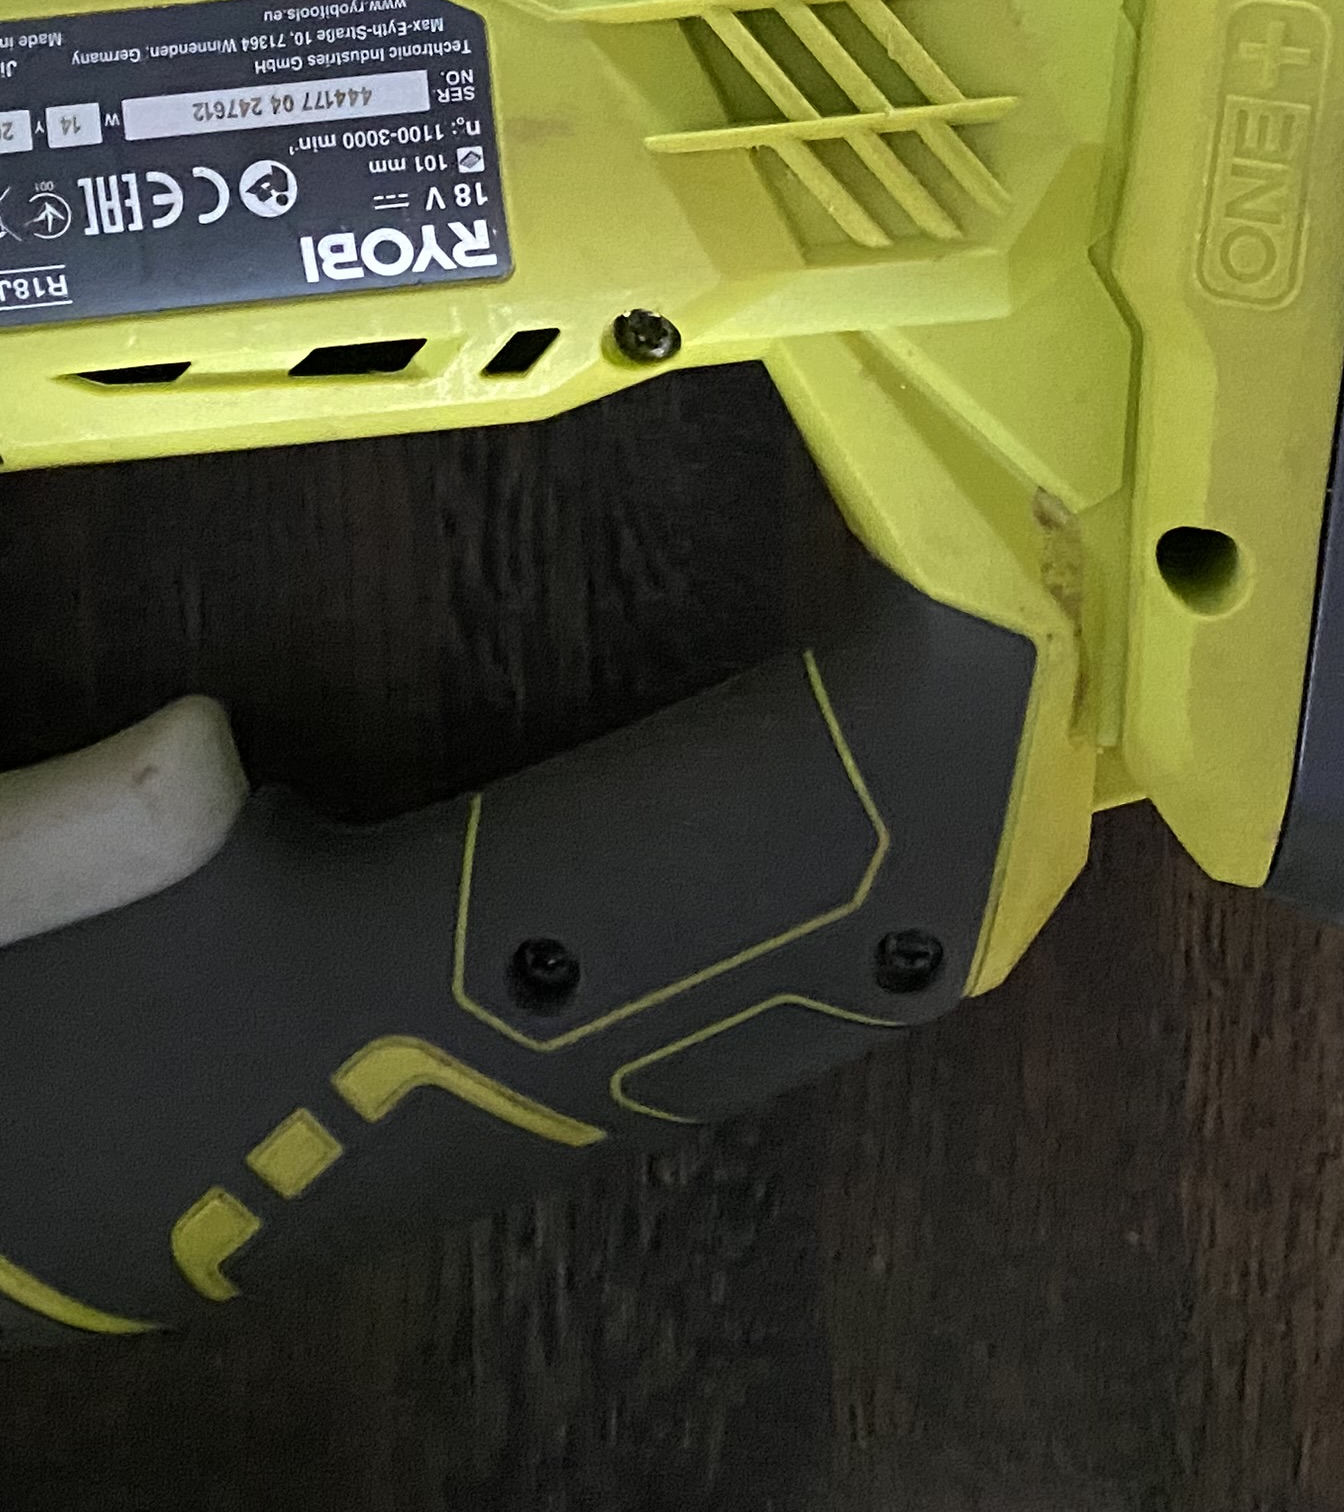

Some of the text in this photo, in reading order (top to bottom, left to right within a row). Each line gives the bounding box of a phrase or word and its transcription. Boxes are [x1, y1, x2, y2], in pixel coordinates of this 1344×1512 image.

[0, 36, 14, 51] in
[18, 31, 61, 49] Made
[71, 17, 444, 67] Max-Eyth-Straße 10, 71364 Winnenden, Germany
[254, 40, 471, 74] Techtronic Industries GmbH
[440, 69, 474, 84] NO.
[192, 87, 373, 122] 444177 04 247612
[35, 121, 45, 133] Y
[60, 116, 81, 135] 14
[104, 113, 120, 127] W
[343, 124, 444, 147] 1100-3000
[368, 154, 447, 174] 101 mm
[426, 182, 488, 210] 18 V
[300, 219, 497, 283] RYOBI
